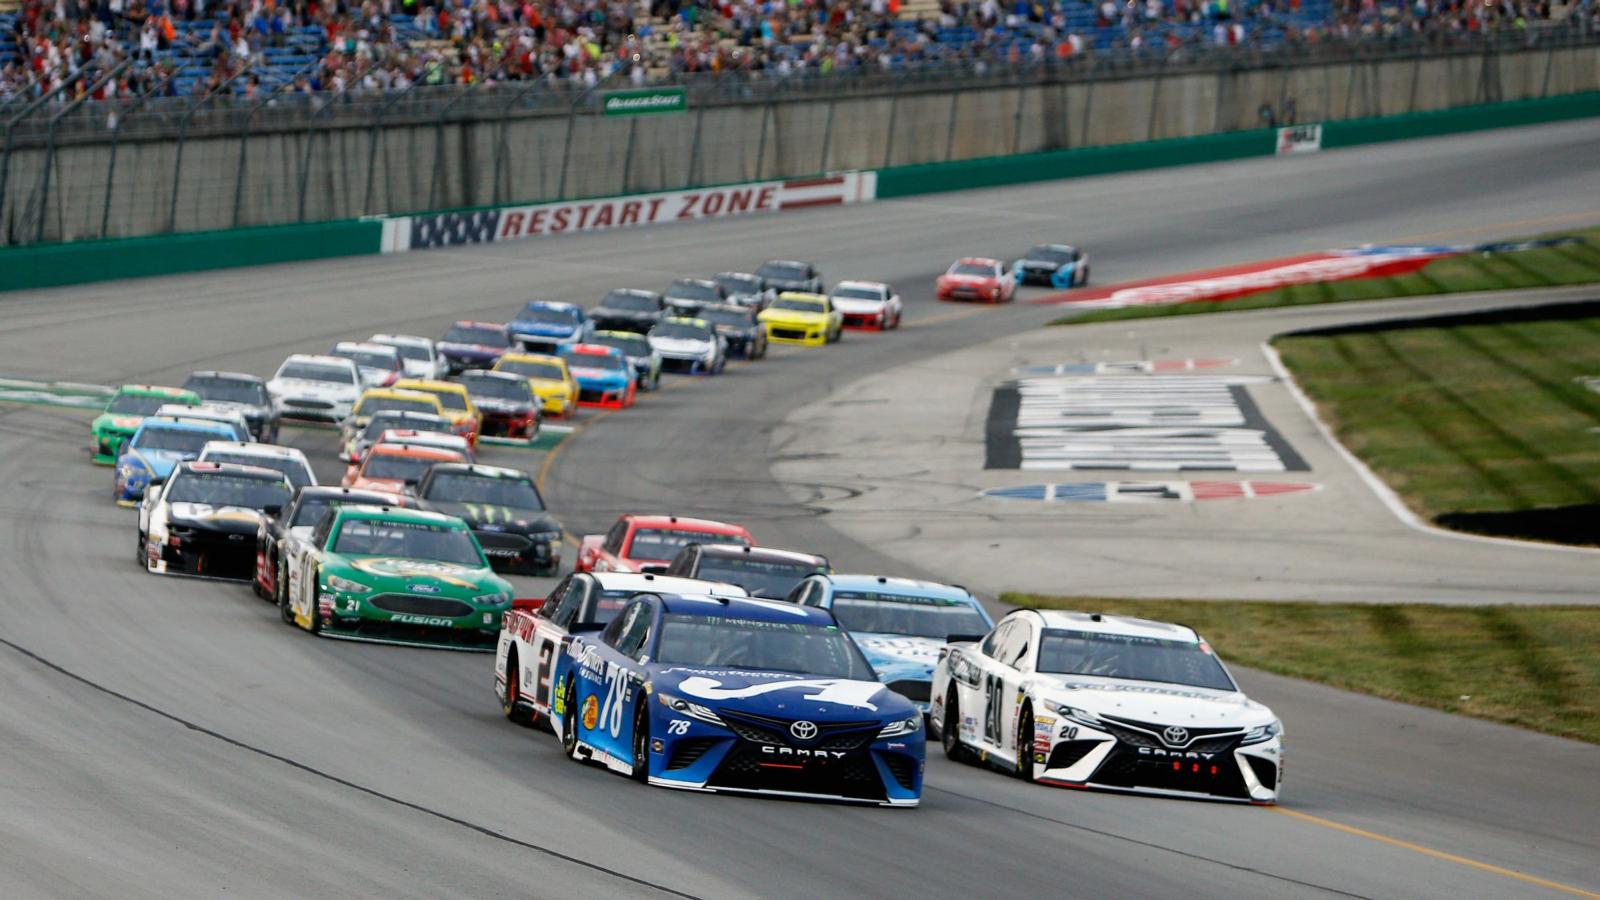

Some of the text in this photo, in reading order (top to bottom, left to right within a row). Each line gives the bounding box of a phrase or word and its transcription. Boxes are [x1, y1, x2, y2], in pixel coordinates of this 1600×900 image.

[501, 186, 776, 237] RESTART ZONE
[347, 599, 360, 612] 21
[390, 614, 453, 627] FUSION
[536, 638, 555, 706] 2
[600, 660, 628, 738] 78
[983, 671, 1005, 748] 20
[667, 719, 691, 735] 78
[1059, 725, 1079, 739] 20
[762, 746, 846, 759] CAMRY
[1138, 746, 1215, 760] CAMRY
